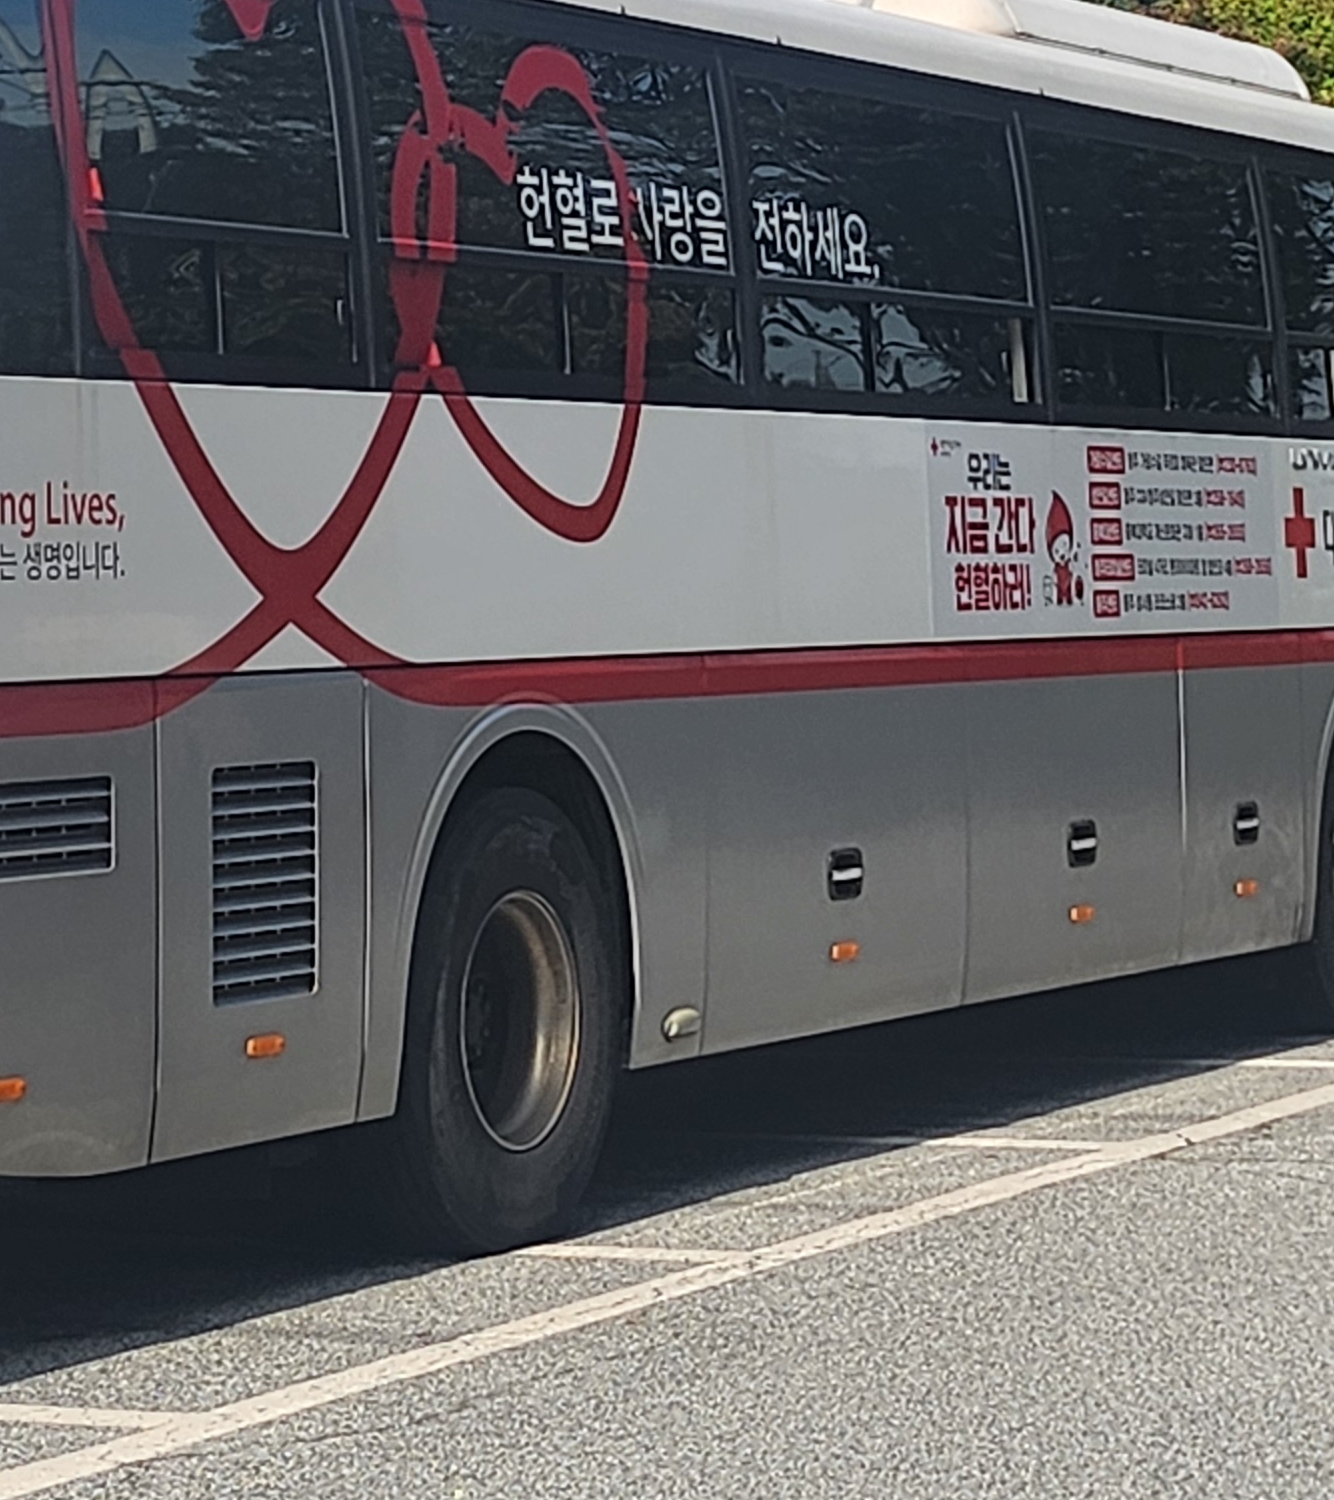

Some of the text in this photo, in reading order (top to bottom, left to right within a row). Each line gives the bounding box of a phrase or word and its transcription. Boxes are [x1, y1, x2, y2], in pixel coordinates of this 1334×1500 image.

[515, 164, 625, 252] 헌혈로
[629, 183, 728, 265] 사랑을
[967, 452, 1012, 491] 우리는
[46, 480, 126, 532] Lives,
[944, 495, 990, 555] 지금
[992, 495, 1036, 555] 간다
[22, 541, 126, 581] 생명입니다.
